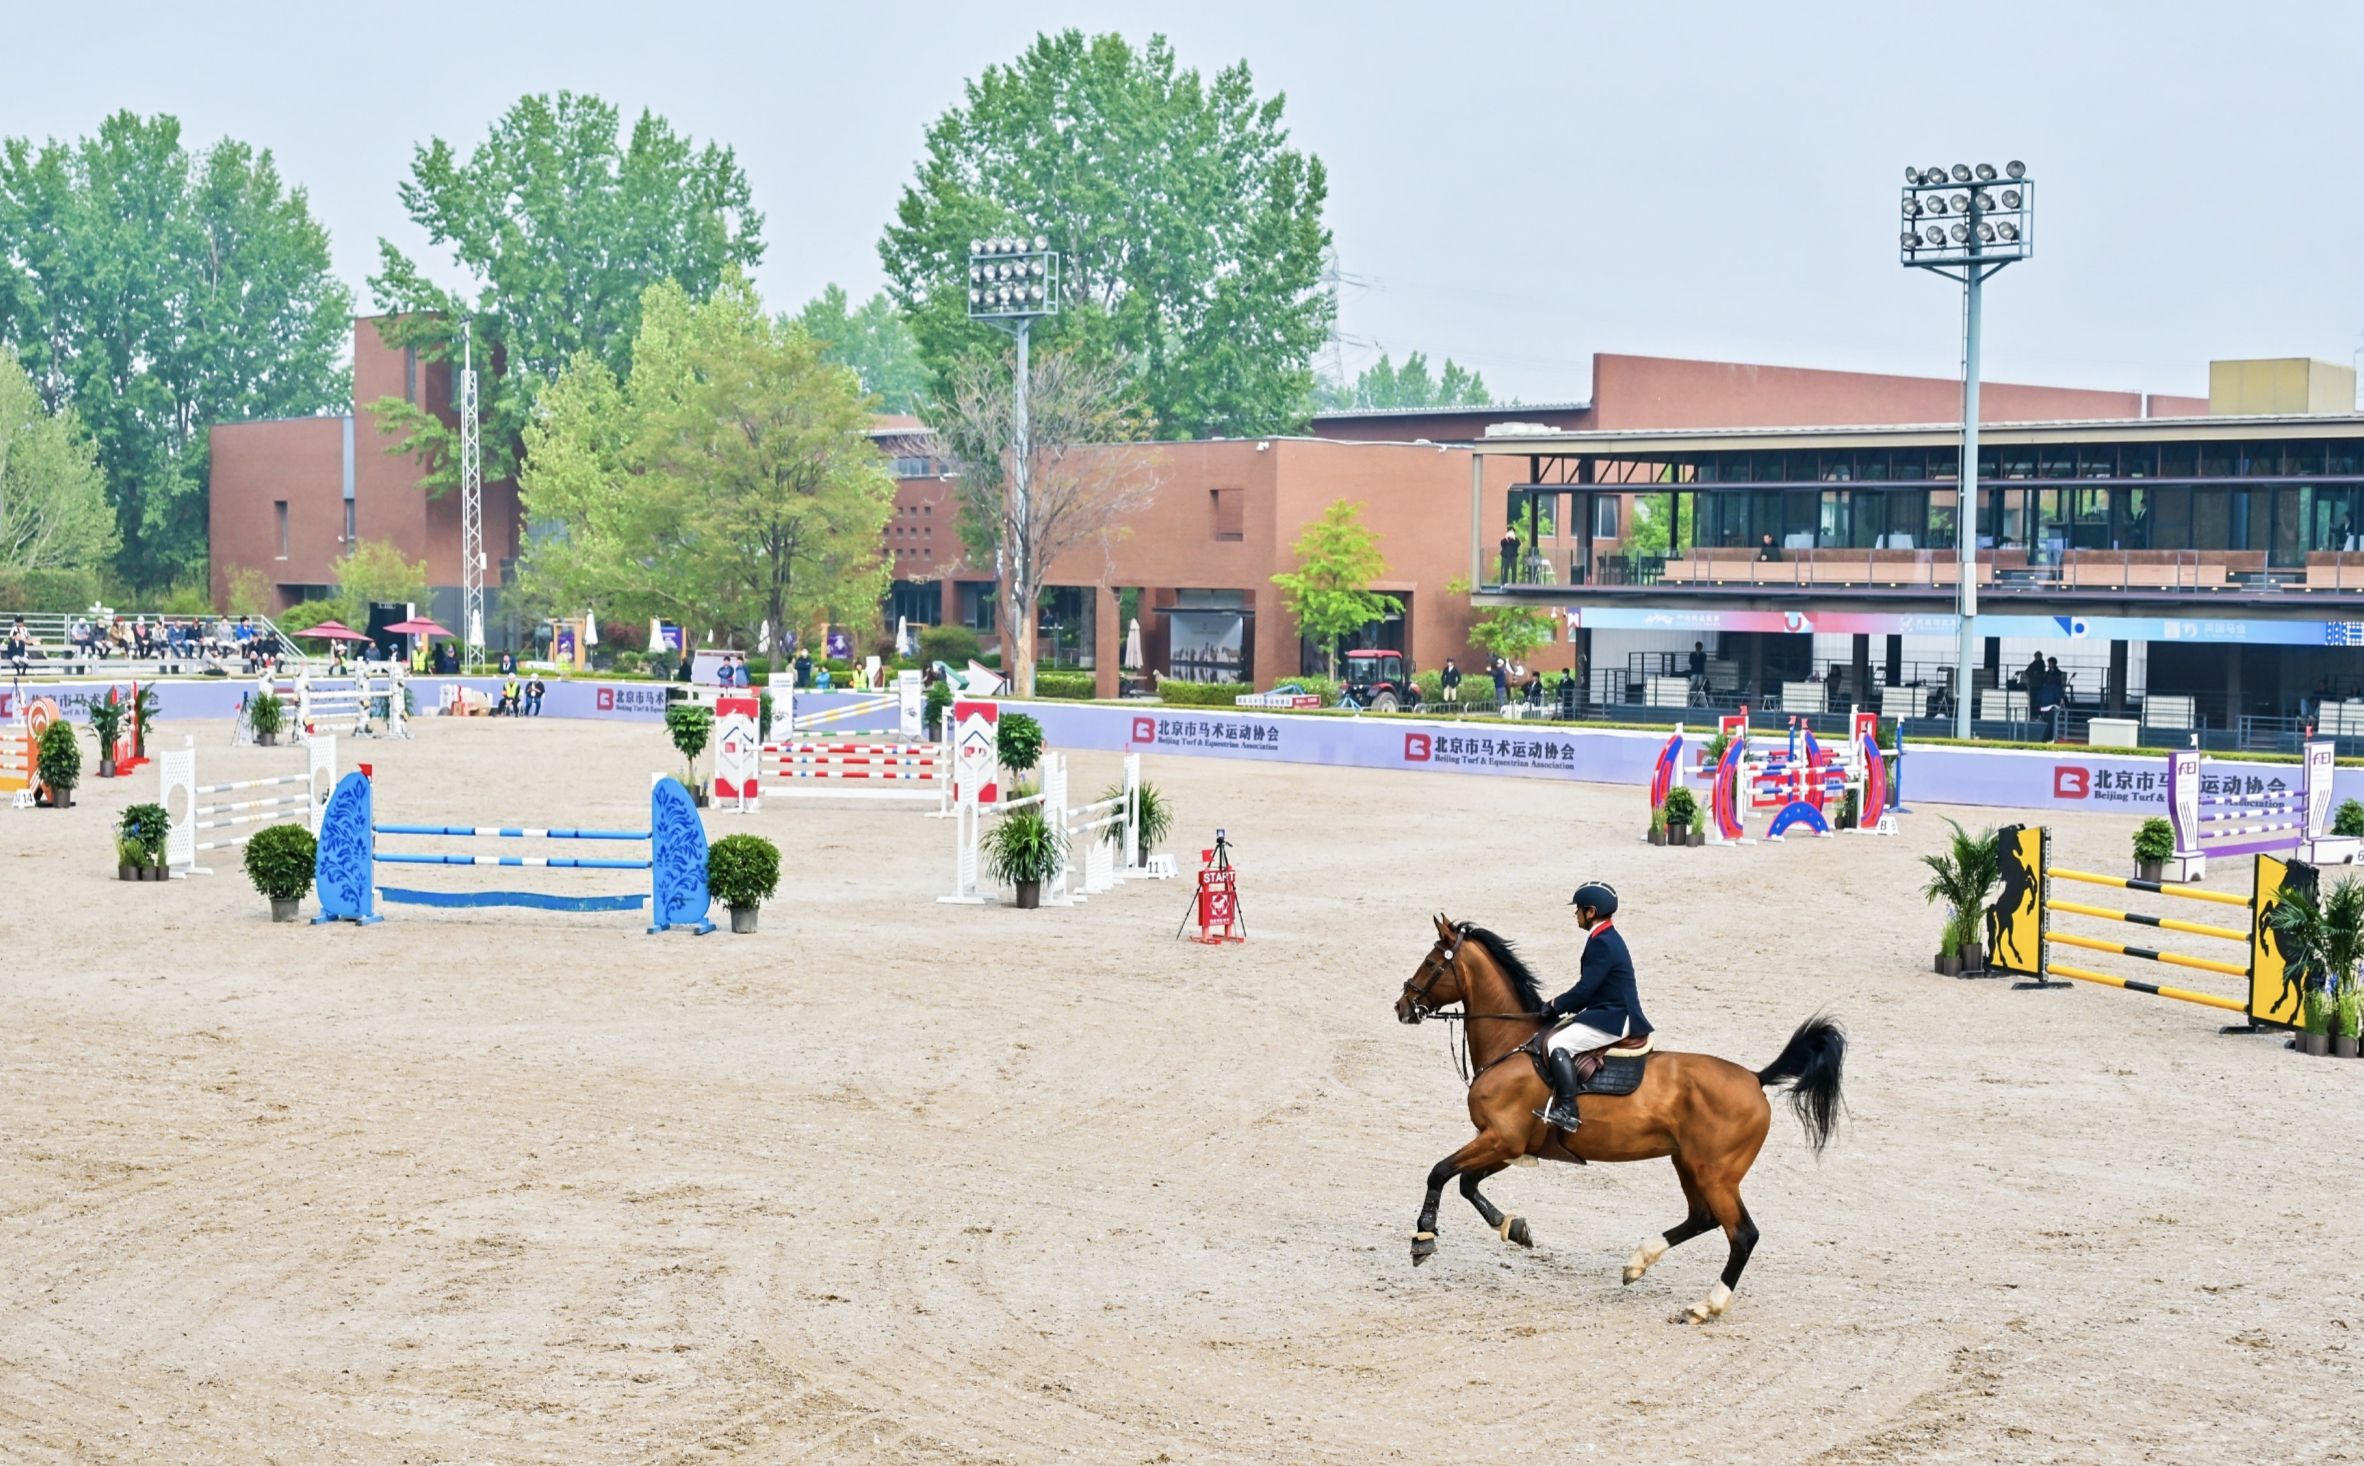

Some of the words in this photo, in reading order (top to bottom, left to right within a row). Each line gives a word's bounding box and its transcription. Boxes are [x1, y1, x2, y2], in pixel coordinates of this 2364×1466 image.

[1158, 720, 1279, 741] 北京市马术运动协会
[1158, 736, 1180, 746] Beijing
[1181, 738, 1197, 746] Turf
[1204, 739, 1239, 749] Equestrian
[1241, 742, 1279, 751] Association
[1435, 736, 1575, 759] 北京市马术运动协会
[1434, 754, 1460, 765] Beijing
[1461, 755, 1480, 764] Turf
[1480, 757, 1487, 765] &
[1489, 757, 1529, 768] Equestrian
[1531, 760, 1575, 770] Association
[23, 793, 33, 803] 14
[2094, 790, 2129, 803] Beijing
[2133, 792, 2156, 802] Turf
[2156, 793, 2165, 802] &
[1148, 861, 1159, 873] 11
[1204, 872, 1235, 883] START
